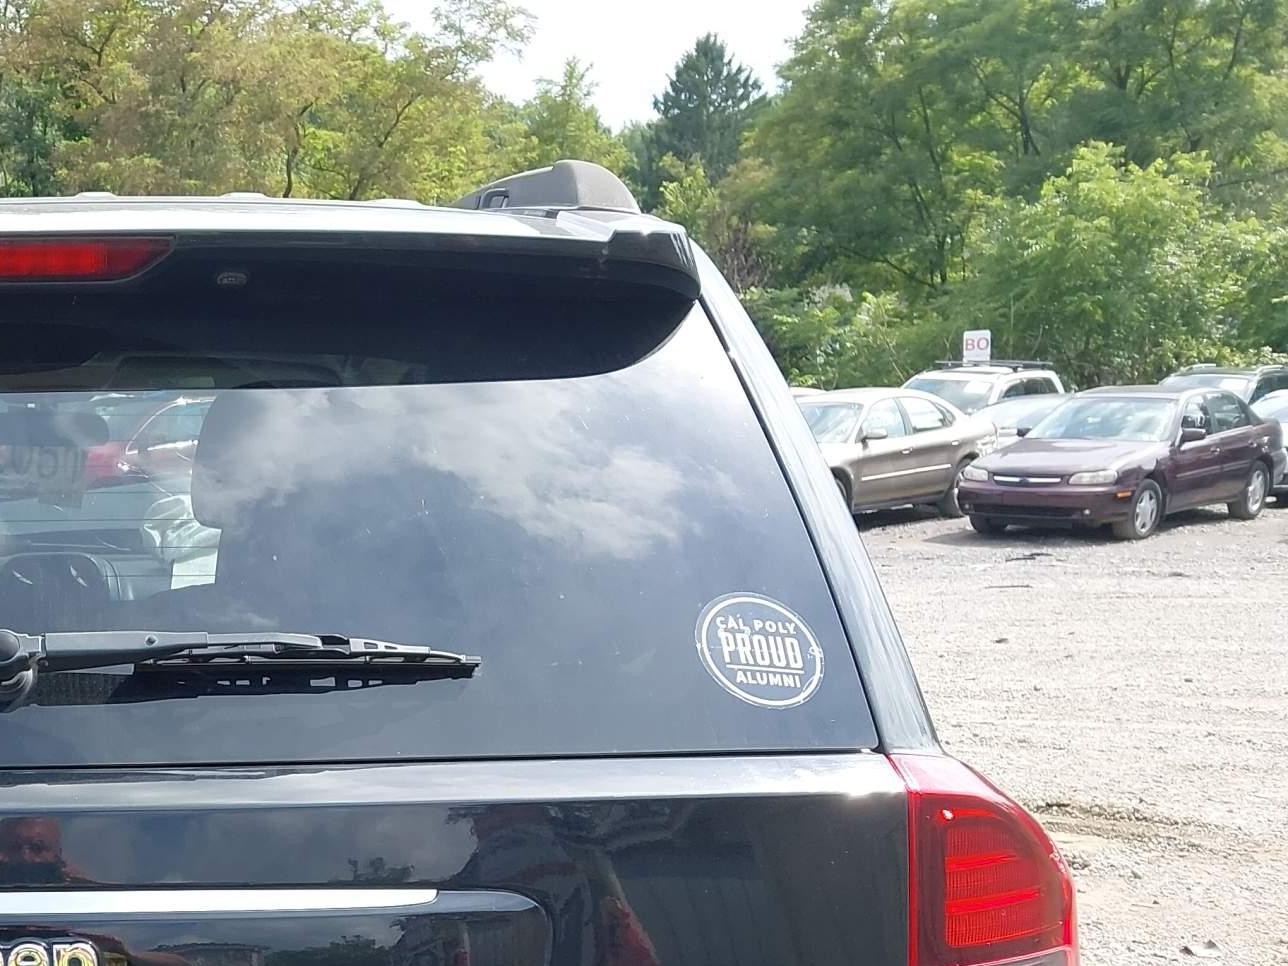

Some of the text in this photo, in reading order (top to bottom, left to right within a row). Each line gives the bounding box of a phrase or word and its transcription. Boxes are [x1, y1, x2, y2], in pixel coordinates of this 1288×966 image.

[716, 615, 797, 634] CAL POLY
[719, 630, 804, 669] PROUD
[736, 670, 801, 688] ALUMNI
